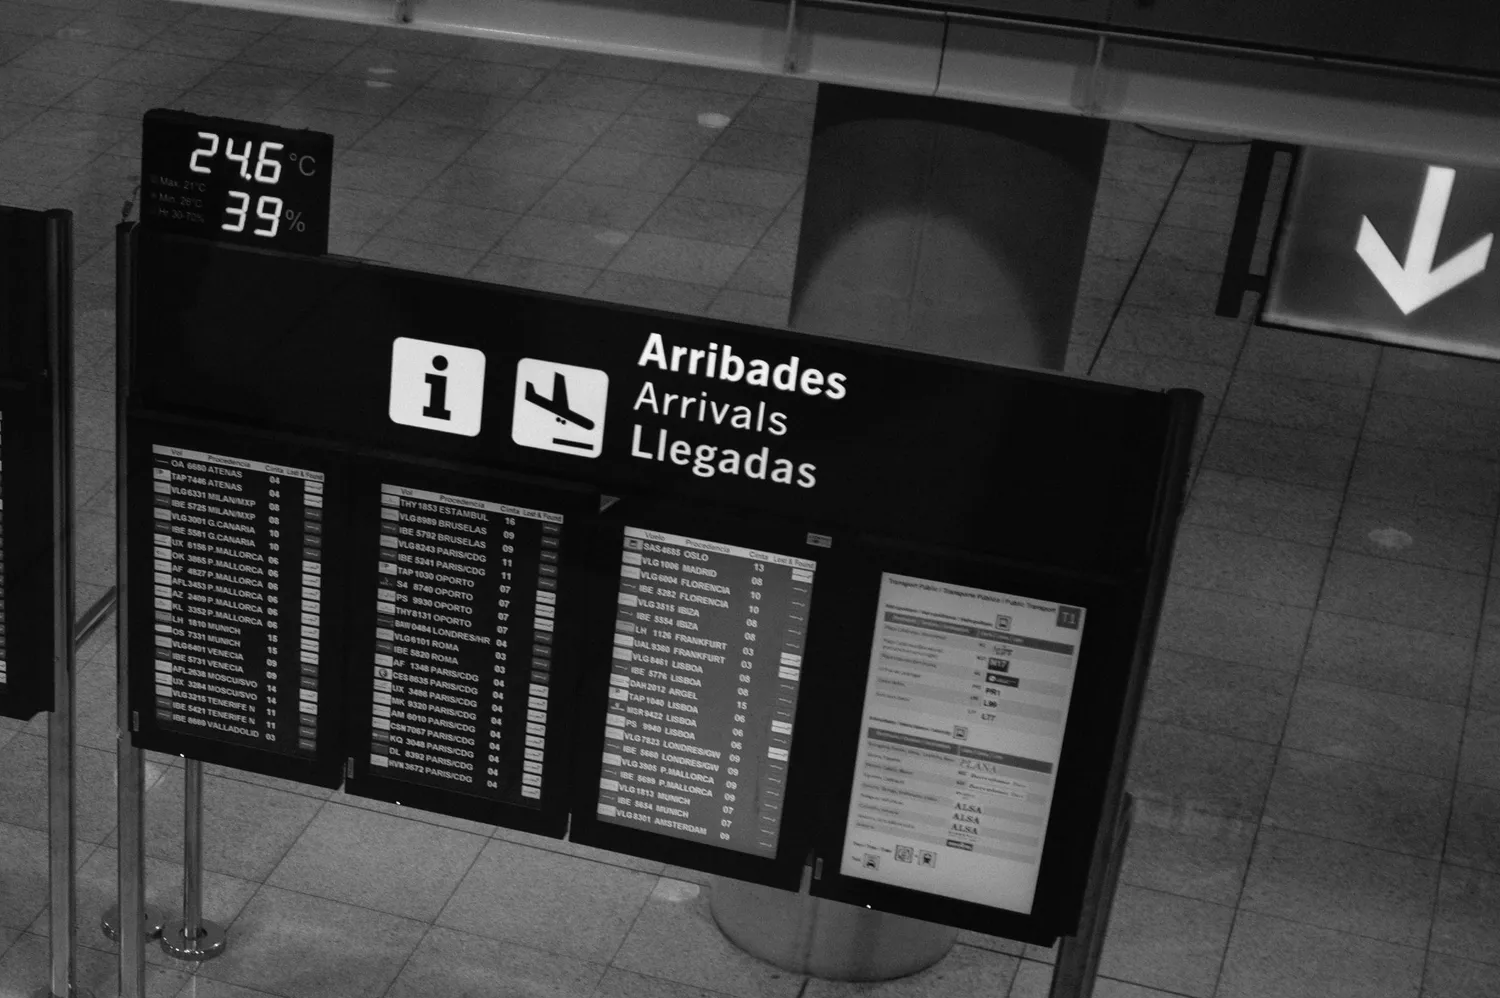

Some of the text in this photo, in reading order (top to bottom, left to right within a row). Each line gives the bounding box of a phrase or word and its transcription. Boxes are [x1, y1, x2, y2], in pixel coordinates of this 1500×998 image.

[189, 131, 284, 184] 24.6
[221, 189, 284, 238] 39
[636, 331, 849, 401] Arribades
[632, 380, 789, 437] Arrivals
[630, 423, 818, 489] Llegadas
[207, 465, 243, 478] ATENAS
[206, 478, 242, 492] ATENAS
[438, 505, 516, 526] ESTAMBUL 16
[268, 528, 280, 538] 10
[437, 518, 487, 535] BRUSELAS
[398, 526, 414, 536] IBE
[436, 532, 486, 549] BRUSELAS
[501, 543, 514, 553] 09
[397, 552, 413, 563] IBE
[500, 571, 511, 580] 11
[682, 549, 764, 572] OSLO 13
[681, 563, 717, 578] MADRID
[434, 573, 475, 588] OPORTO
[680, 577, 730, 595] FLORENCIA
[396, 579, 408, 589] S4
[433, 586, 473, 601] OPORTO
[497, 598, 510, 608] 07
[638, 584, 654, 594] IBE
[678, 591, 729, 608] FLORENCIA
[748, 604, 759, 614] 10
[394, 591, 408, 602] PS
[433, 600, 473, 614] OPORTO
[496, 611, 510, 621] 07
[676, 605, 700, 617] IBIZA
[432, 613, 472, 628] OPORTO
[675, 619, 698, 631] IBIZA
[206, 621, 278, 642] MUNICH 15
[206, 634, 241, 648] MUNICH
[430, 639, 459, 652] ROMA
[674, 632, 727, 650] FRANKFURT
[206, 646, 244, 660] VENECIA
[392, 645, 409, 655] IBE
[430, 652, 459, 665] ROMA
[493, 664, 506, 674] 03
[672, 646, 726, 664] FRANKFURT
[206, 658, 244, 673] VENECIA
[671, 659, 703, 674] LISBOA
[669, 673, 702, 687] LISBOA
[667, 686, 698, 700] ARGEL
[206, 695, 276, 716] TENERIFE N 11
[666, 700, 698, 714] LISBOA
[205, 720, 259, 738] VALLADOLID
[490, 716, 502, 726] 04
[665, 713, 743, 737] LISBOA 06
[663, 726, 695, 740] LISBOA
[659, 765, 714, 784] P.MALLORCA
[657, 778, 713, 797] P.MALLORCA
[654, 804, 689, 818] MUNICH
[656, 791, 734, 814] MUNICH 07
[954, 802, 982, 815] ALSA
[653, 816, 707, 835] AMSTERDAM
[952, 812, 980, 825] ALSA
[950, 822, 979, 836] ALSA
